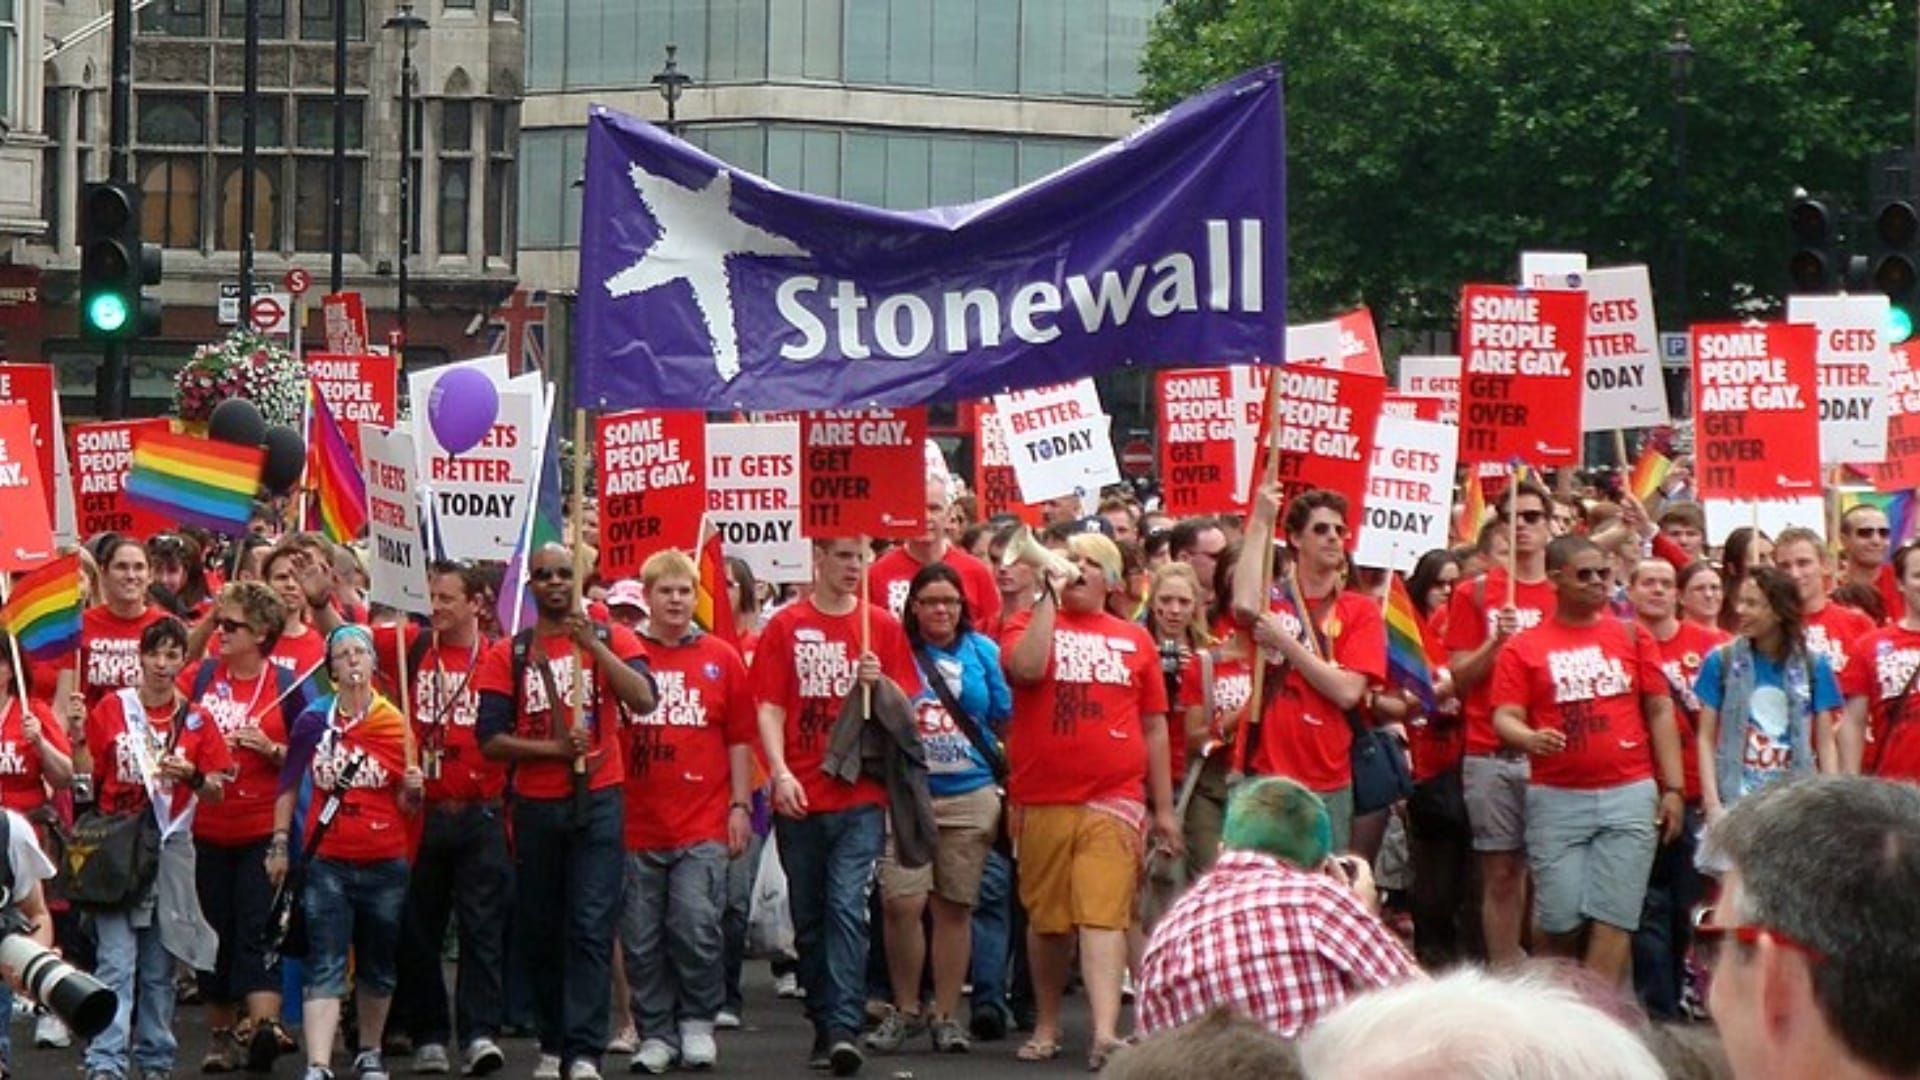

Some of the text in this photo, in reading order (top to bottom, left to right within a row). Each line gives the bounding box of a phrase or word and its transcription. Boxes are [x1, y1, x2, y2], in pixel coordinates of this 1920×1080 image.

[291, 273, 305, 291] S
[774, 219, 1264, 361] Stonewall
[1471, 297, 1540, 322] SOME
[1589, 300, 1639, 325] GETS
[1471, 323, 1557, 349] PEOPLE
[1587, 333, 1649, 358] TTER...
[1671, 339, 1685, 356] P
[1700, 333, 1768, 359] SOME
[1829, 328, 1876, 351] GETS
[1468, 351, 1572, 377] ARE GAY.
[1701, 358, 1787, 386] PEOPLE
[1165, 377, 1221, 400] SOME
[1411, 376, 1423, 391] IT
[1469, 377, 1512, 400] GET
[1586, 365, 1645, 391] ODAY
[1701, 385, 1806, 412] ARE GAY.
[1818, 397, 1874, 422] ODAY
[346, 402, 385, 422] GAY.
[1468, 403, 1529, 427] OVER
[478, 425, 518, 448] ETS
[604, 418, 663, 448] SOME
[808, 420, 913, 447] ARE GAY.
[1168, 423, 1210, 444] ARE
[1705, 413, 1746, 436] GET
[77, 430, 131, 452] SOME
[1025, 428, 1093, 463] TODAY
[1313, 430, 1361, 462] GAY.
[1467, 429, 1498, 452] IT!
[1706, 439, 1765, 462] OVER
[79, 450, 136, 473] PEOP
[605, 438, 680, 472] PEOPLE
[808, 449, 854, 472] GET
[1171, 443, 1204, 463] GET
[1373, 446, 1441, 474] T GETS
[605, 459, 696, 497] ARE GAY.
[712, 454, 794, 478] IT GETS
[1171, 464, 1221, 485] OVER
[1706, 465, 1736, 488] IT!
[81, 472, 118, 495] ARE
[808, 476, 871, 500] OVER
[1172, 485, 1198, 506] IT!
[1371, 477, 1442, 505] ETTER...
[82, 494, 116, 514] GET
[438, 492, 516, 518] TODAY
[607, 493, 645, 519] GET
[809, 503, 841, 527] IT!
[85, 513, 133, 534] OVER
[608, 516, 662, 543] OVER
[715, 519, 793, 545] TODAY
[1363, 507, 1433, 536] TODAY
[608, 543, 635, 568] IT!
[793, 641, 848, 660] SOME
